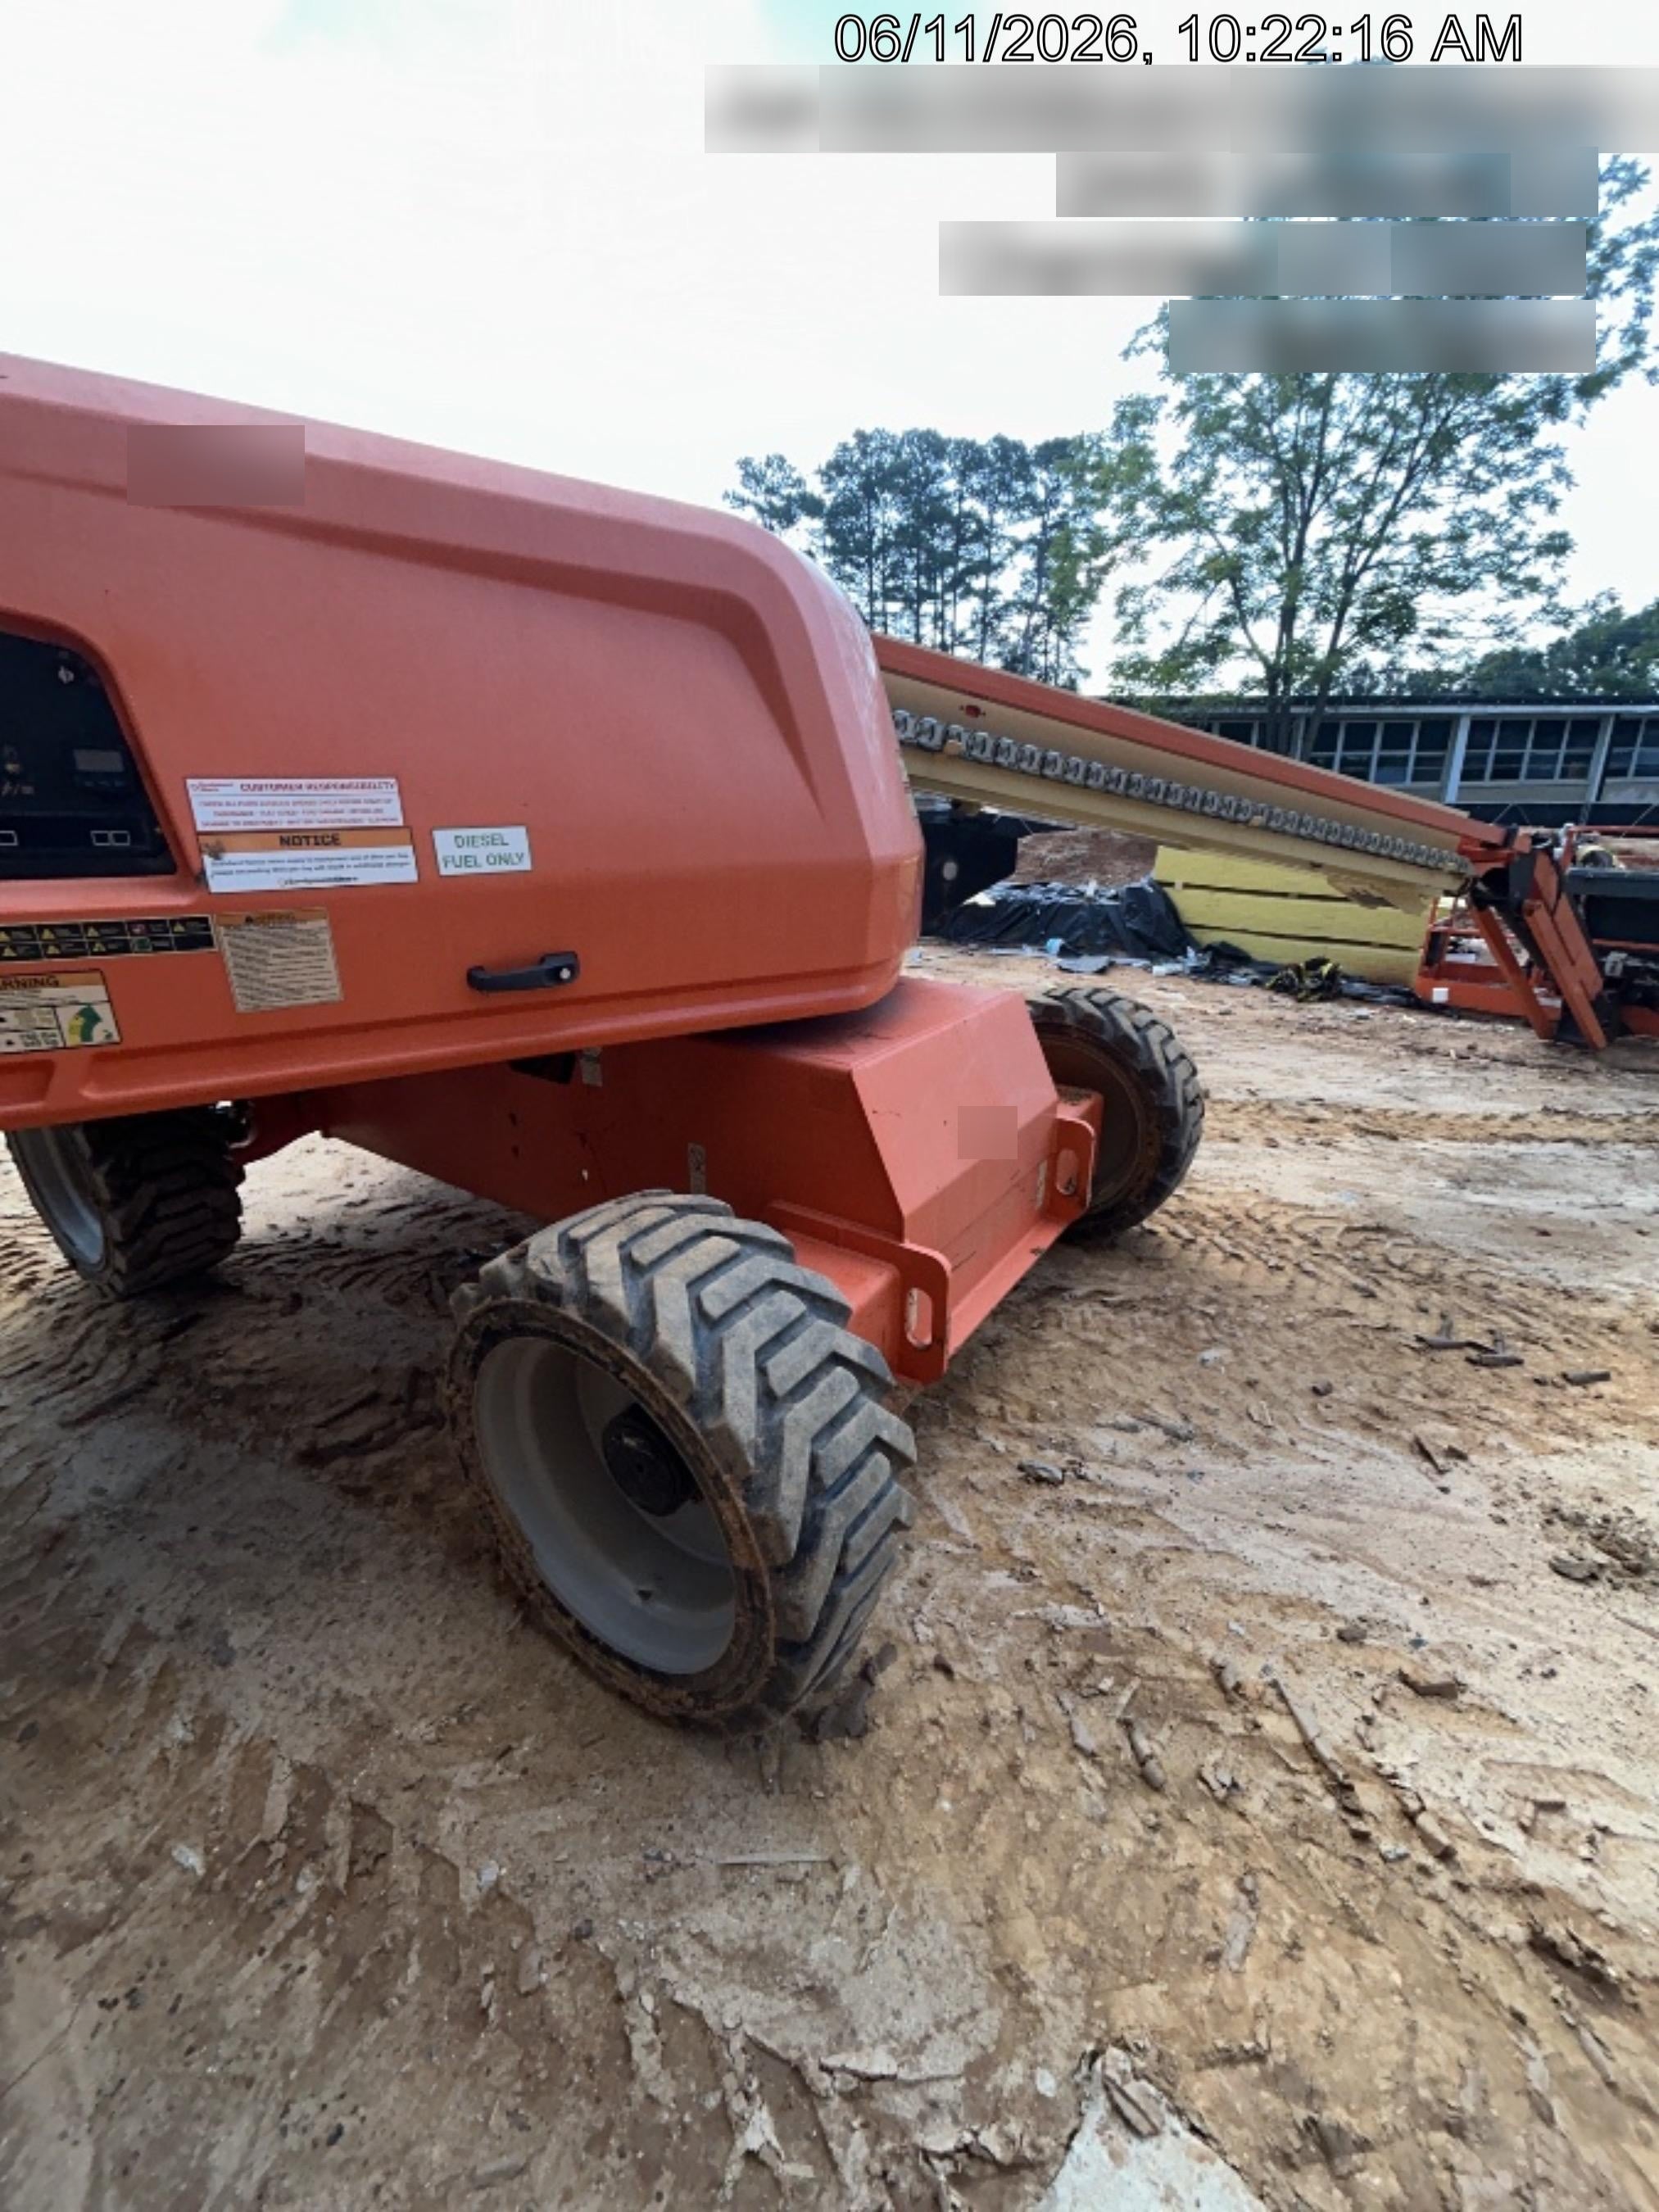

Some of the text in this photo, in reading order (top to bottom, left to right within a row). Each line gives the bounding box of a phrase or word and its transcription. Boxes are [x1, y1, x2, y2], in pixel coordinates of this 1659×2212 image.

[279, 833, 342, 847] NOTICE
[454, 832, 510, 849] DIESEL
[442, 852, 524, 868] FUEL ONLY
